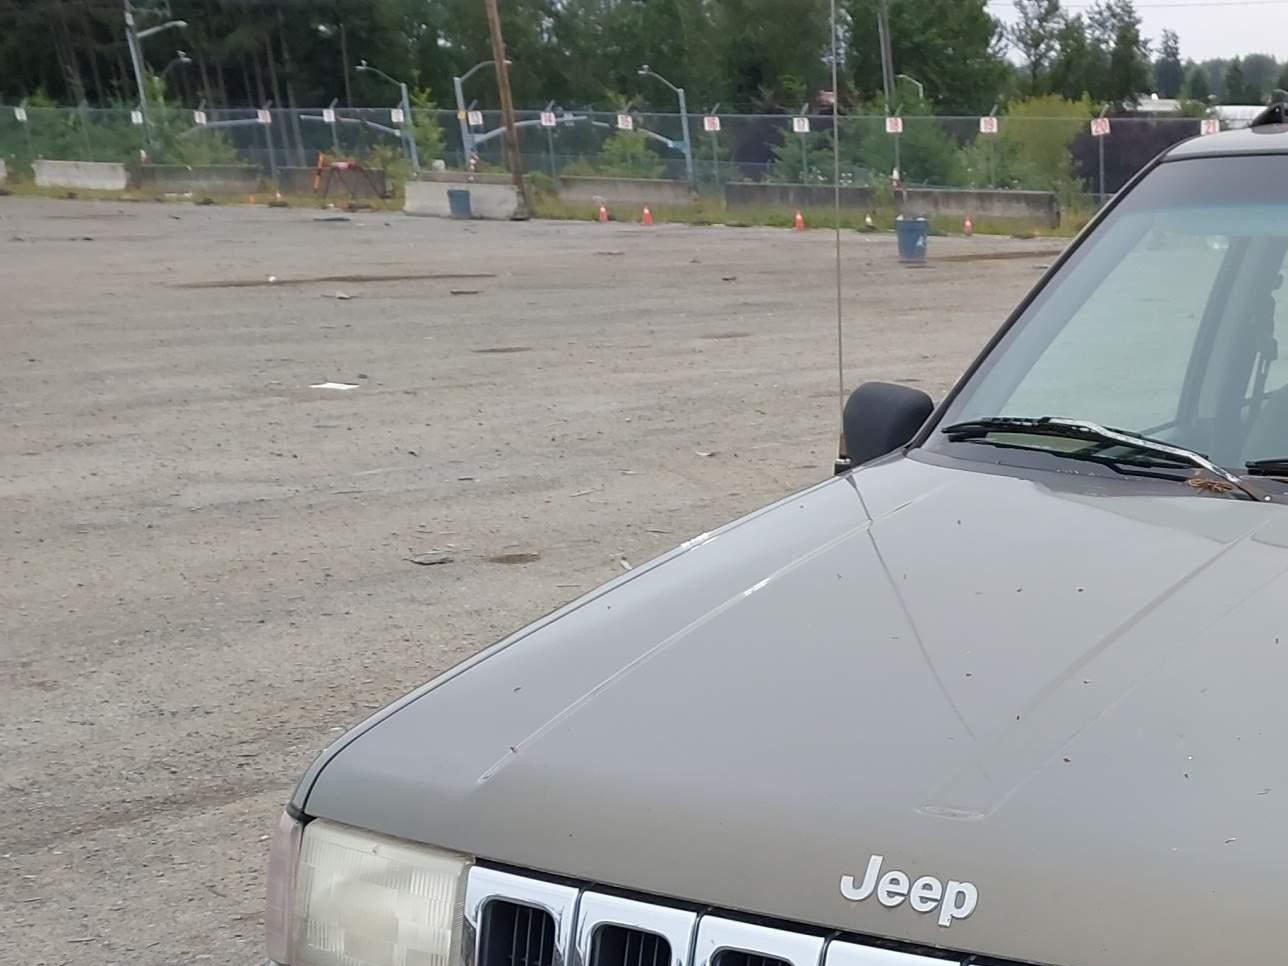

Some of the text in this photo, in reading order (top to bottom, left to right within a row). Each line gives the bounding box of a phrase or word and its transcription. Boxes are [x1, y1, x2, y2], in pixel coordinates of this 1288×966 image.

[1093, 118, 1109, 134] 20
[1204, 120, 1217, 135] 21
[840, 854, 979, 928] Jeep
